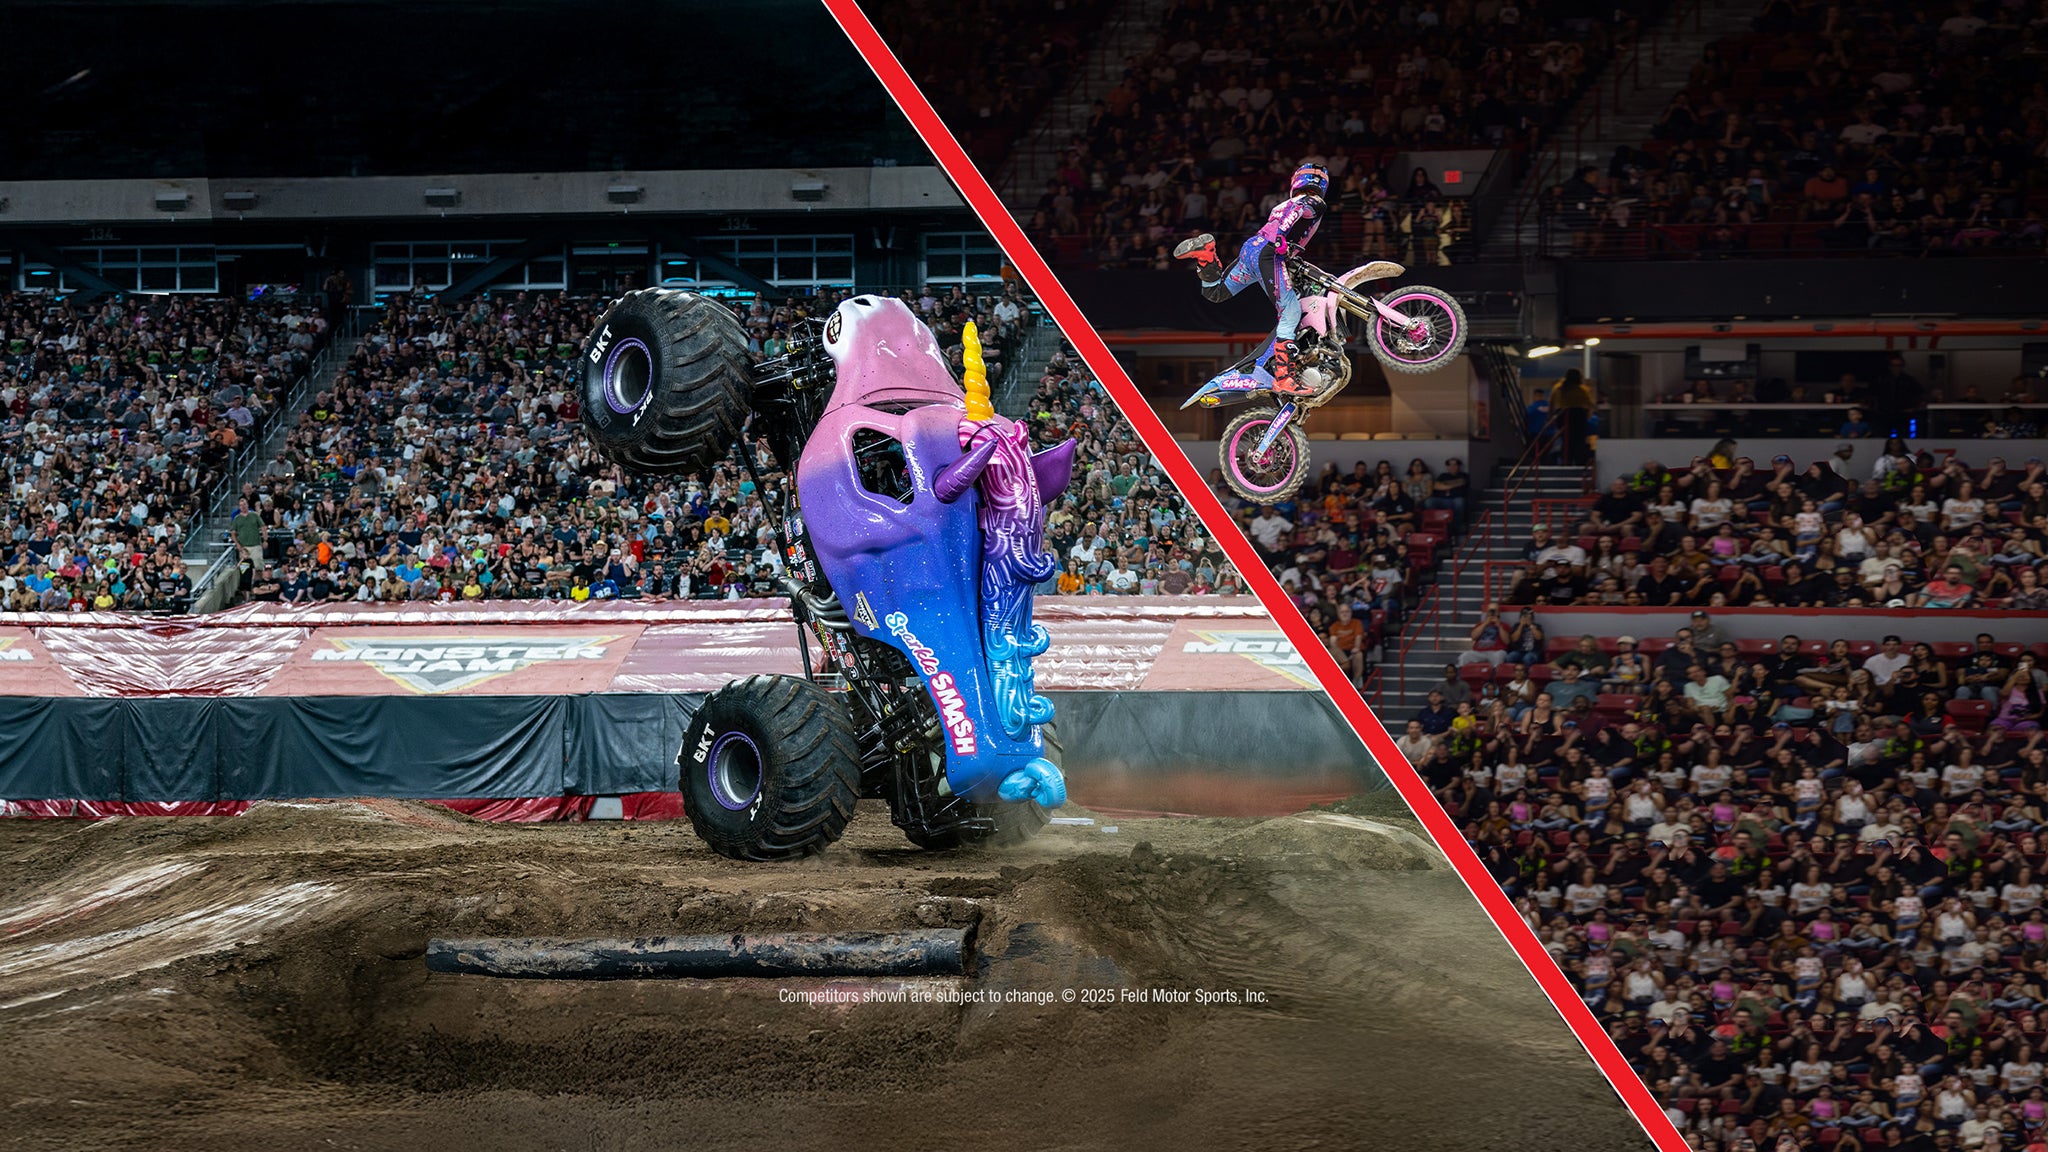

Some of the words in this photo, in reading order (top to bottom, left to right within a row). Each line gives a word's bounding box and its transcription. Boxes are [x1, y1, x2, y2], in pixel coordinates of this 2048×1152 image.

[590, 324, 612, 364] BKT
[1222, 378, 1258, 389] SMASH
[855, 593, 875, 631] MONSTER
[310, 646, 606, 661] MONSTER
[885, 611, 939, 675] Sparkle
[382, 658, 518, 672] JAM
[931, 672, 976, 755] SMASH
[693, 722, 715, 763] BKT
